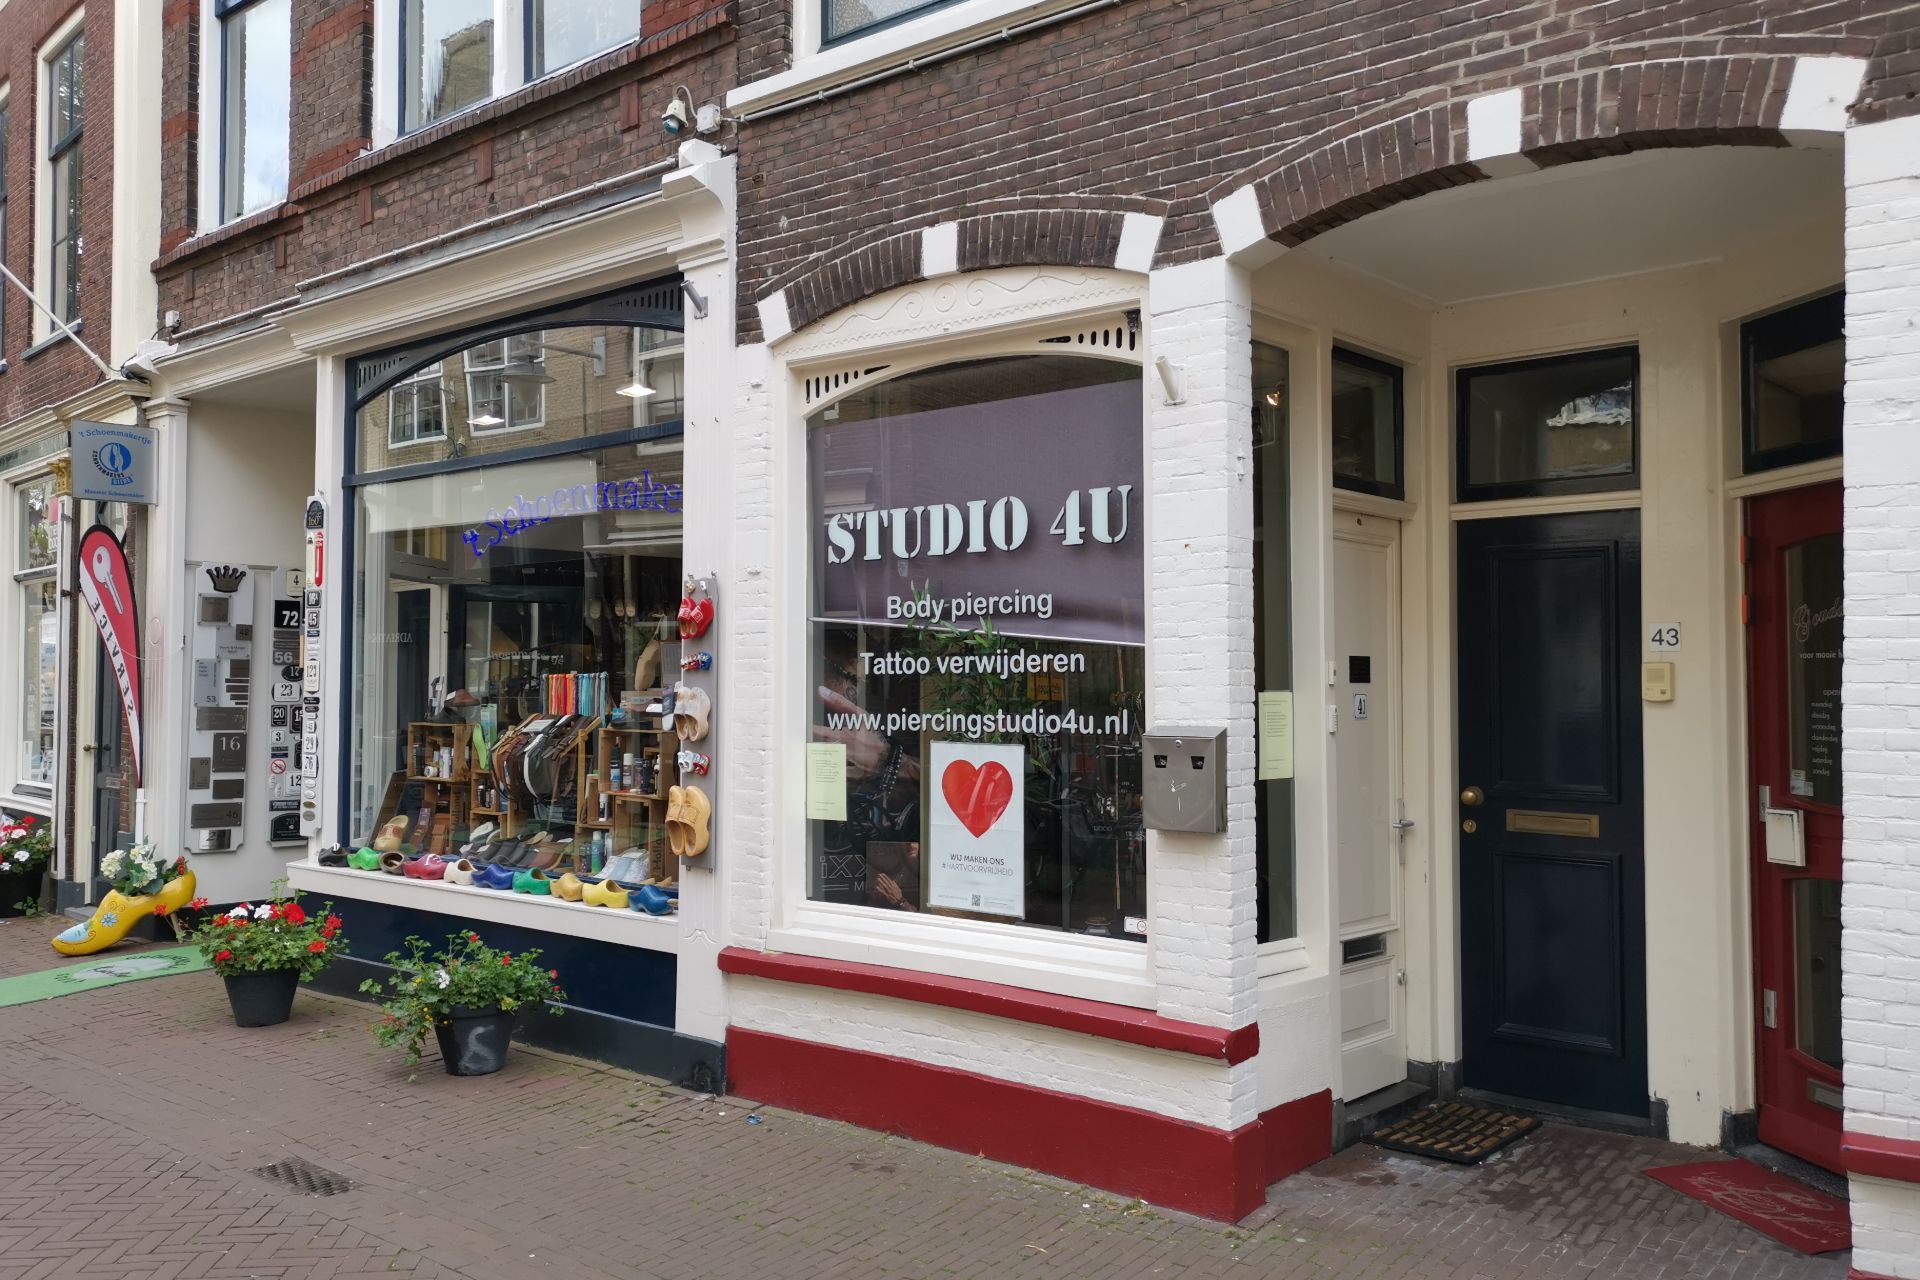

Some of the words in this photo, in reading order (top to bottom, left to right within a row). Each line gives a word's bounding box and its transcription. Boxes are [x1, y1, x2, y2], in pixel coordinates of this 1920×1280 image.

[86, 429, 152, 445] Schoenmakertje
[827, 495, 1029, 565] STUDIO
[1049, 484, 1133, 546] 4U
[293, 574, 299, 585] 4
[886, 595, 944, 623] Body
[950, 589, 1053, 623] piercing
[281, 610, 299, 626] 72
[1651, 628, 1679, 646] 43
[274, 651, 293, 664] 56
[859, 652, 931, 676] Tattoo
[937, 648, 1085, 679] verwijderen
[281, 684, 293, 697] 23
[1358, 697, 1366, 714] 41
[274, 709, 285, 719] 20
[827, 708, 1129, 738] www.piercingstudio4u.nl
[219, 736, 240, 751] 16
[275, 732, 281, 742] 3
[290, 775, 302, 787] 12
[950, 853, 962, 862] WIJ
[964, 855, 988, 865] MAKEN
[989, 857, 1005, 866] ONS
[941, 862, 1014, 877] #HARTVOORVRIJHEID
